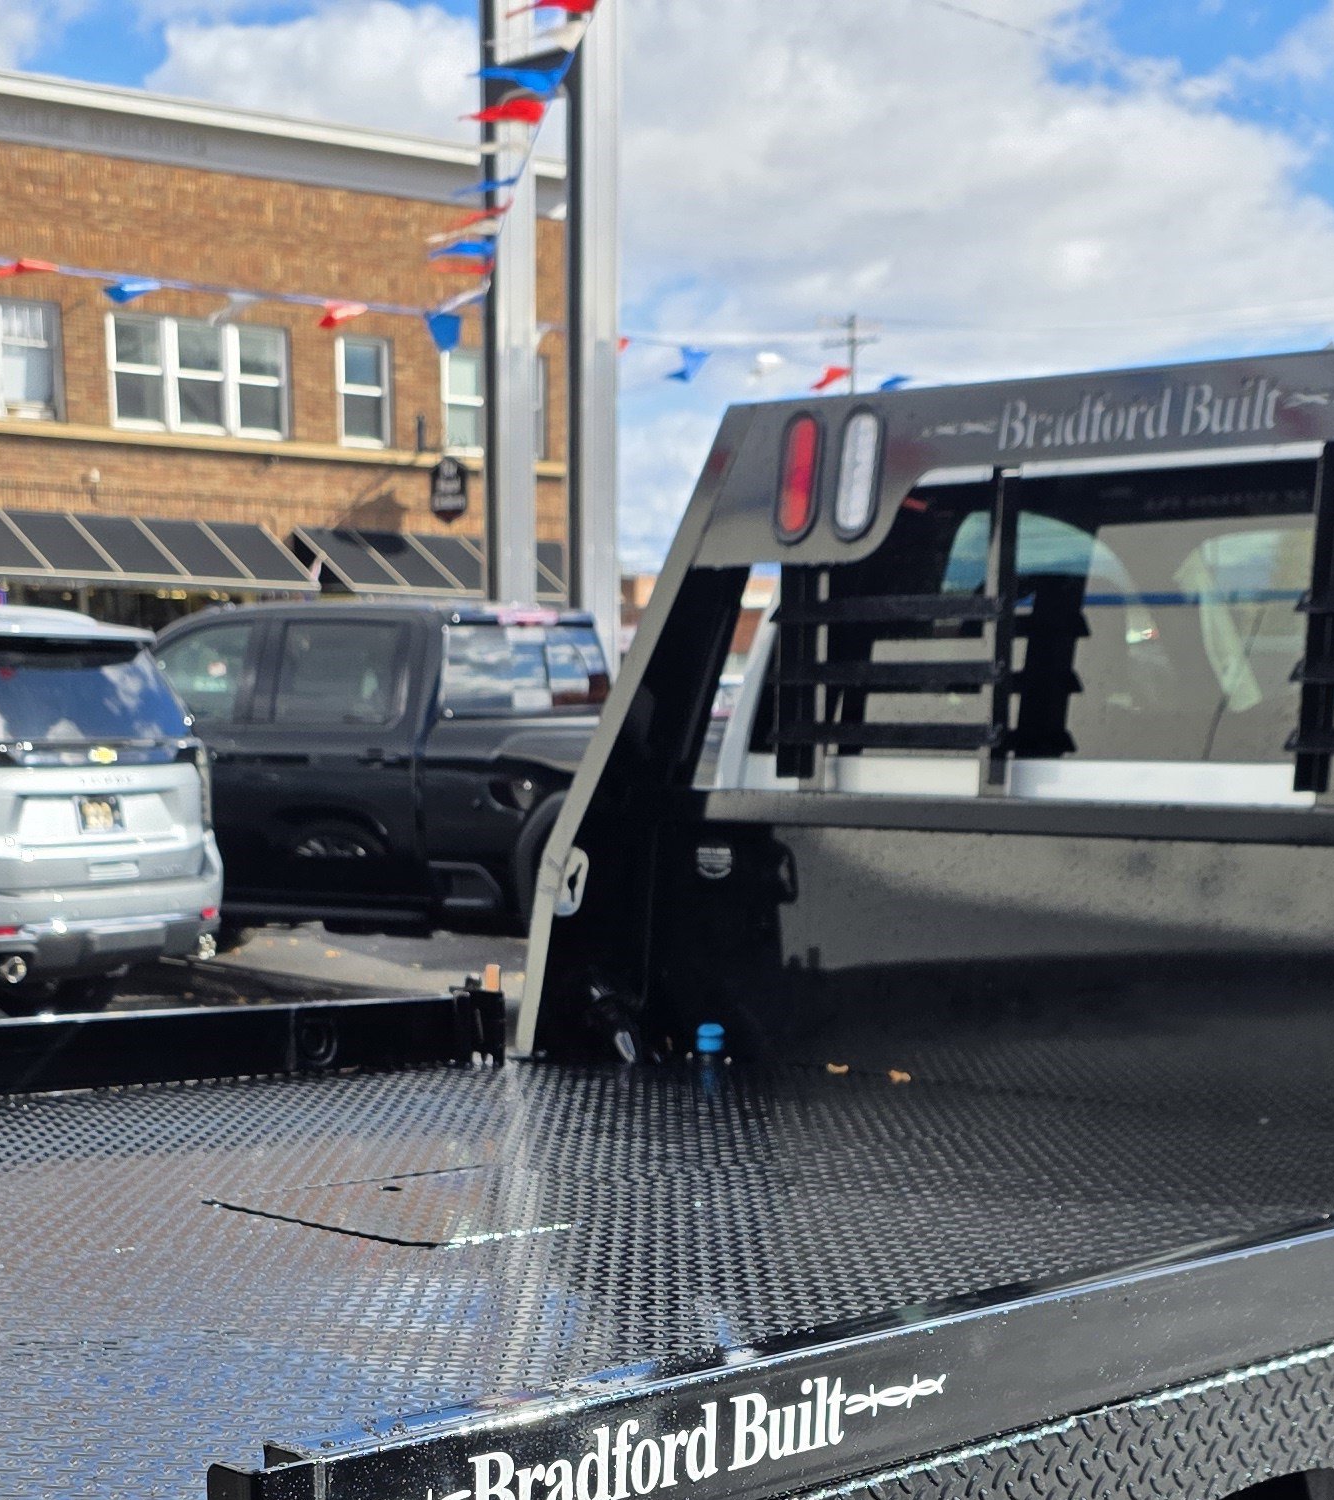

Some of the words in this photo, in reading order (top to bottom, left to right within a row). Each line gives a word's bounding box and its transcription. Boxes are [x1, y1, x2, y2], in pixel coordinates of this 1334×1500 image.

[998, 387, 1172, 450] Bradford
[1181, 376, 1282, 436] Built
[729, 1376, 846, 1471] Built
